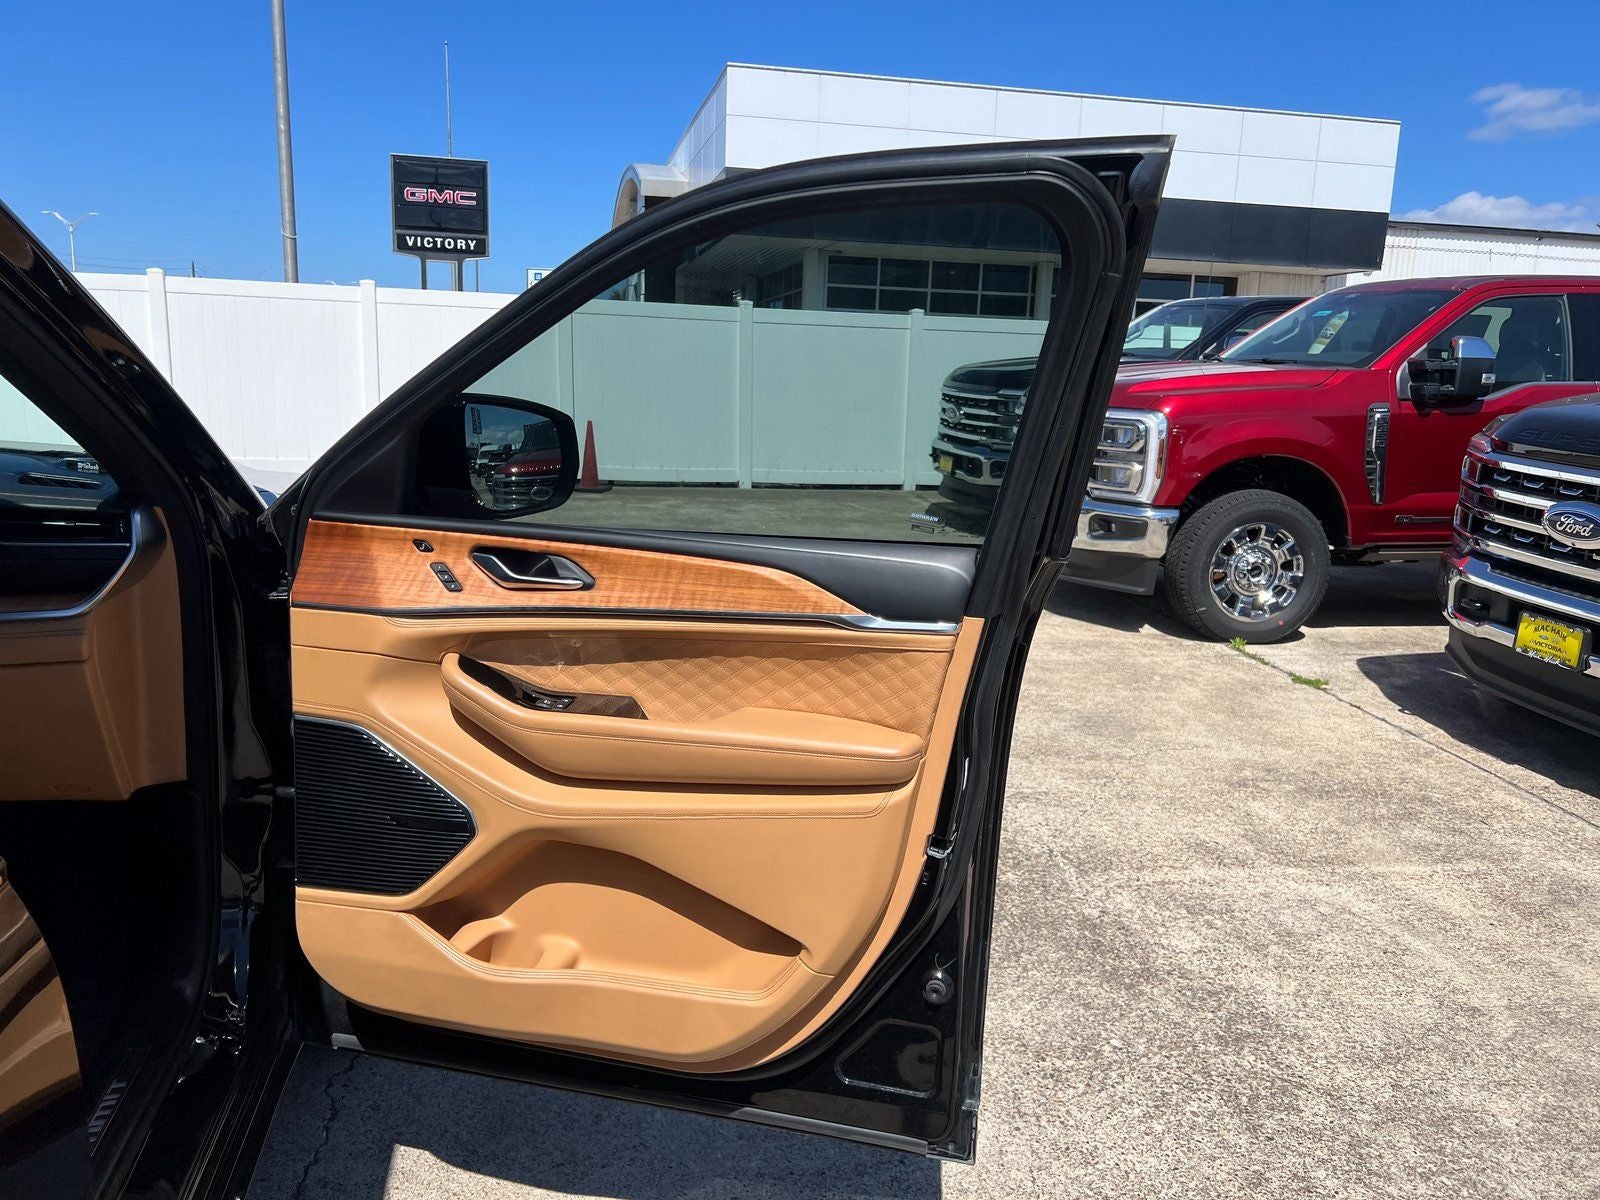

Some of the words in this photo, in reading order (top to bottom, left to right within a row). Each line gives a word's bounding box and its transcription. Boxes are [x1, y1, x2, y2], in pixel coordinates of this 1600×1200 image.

[404, 187, 477, 205] GMC
[406, 236, 477, 250] VICTORY
[1556, 513, 1593, 537] Ford
[1534, 625, 1550, 633] MAC
[1551, 627, 1568, 641] HAIK
[1534, 640, 1563, 653] VICTORIA
